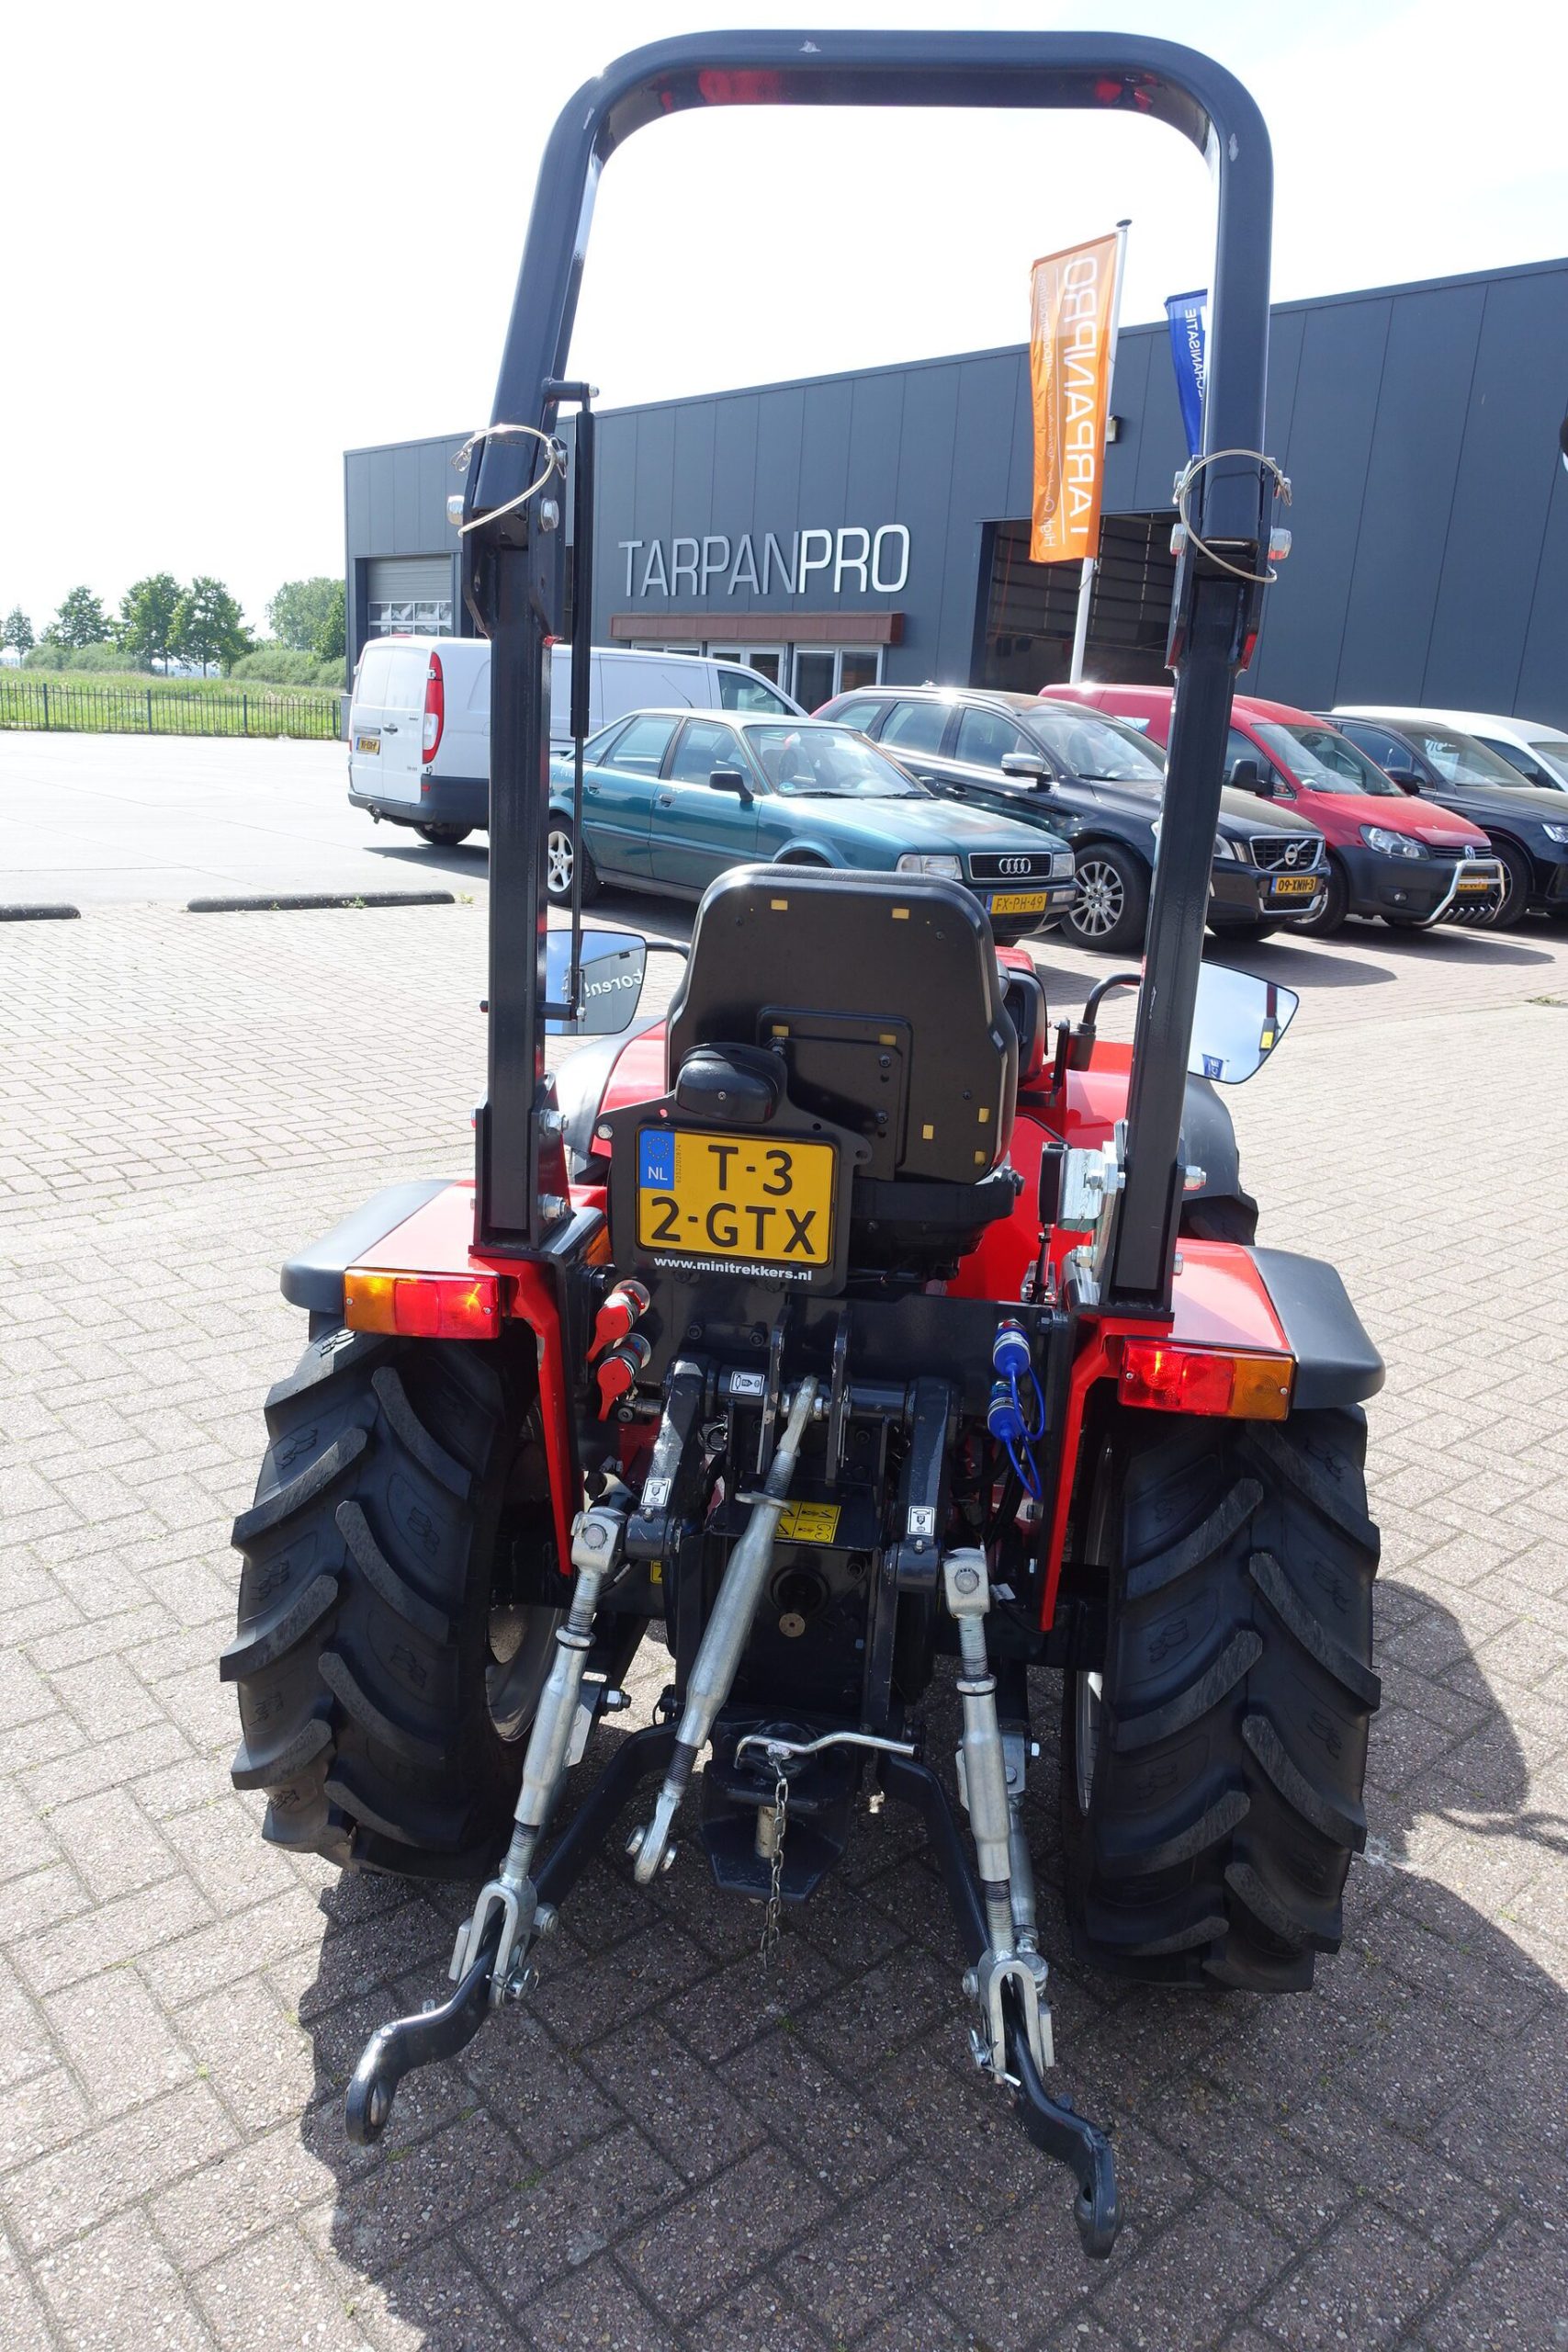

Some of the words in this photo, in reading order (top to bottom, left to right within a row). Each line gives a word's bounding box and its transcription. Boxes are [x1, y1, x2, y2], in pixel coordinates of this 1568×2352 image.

[617, 524, 911, 597] TARPANPRO
[996, 895, 1044, 910] FX-PH-49
[648, 1166, 668, 1181] NL
[708, 1145, 793, 1196] T-3
[651, 1196, 817, 1255] 2-GTX
[654, 1256, 812, 1281] www.minitrekkers.nl
